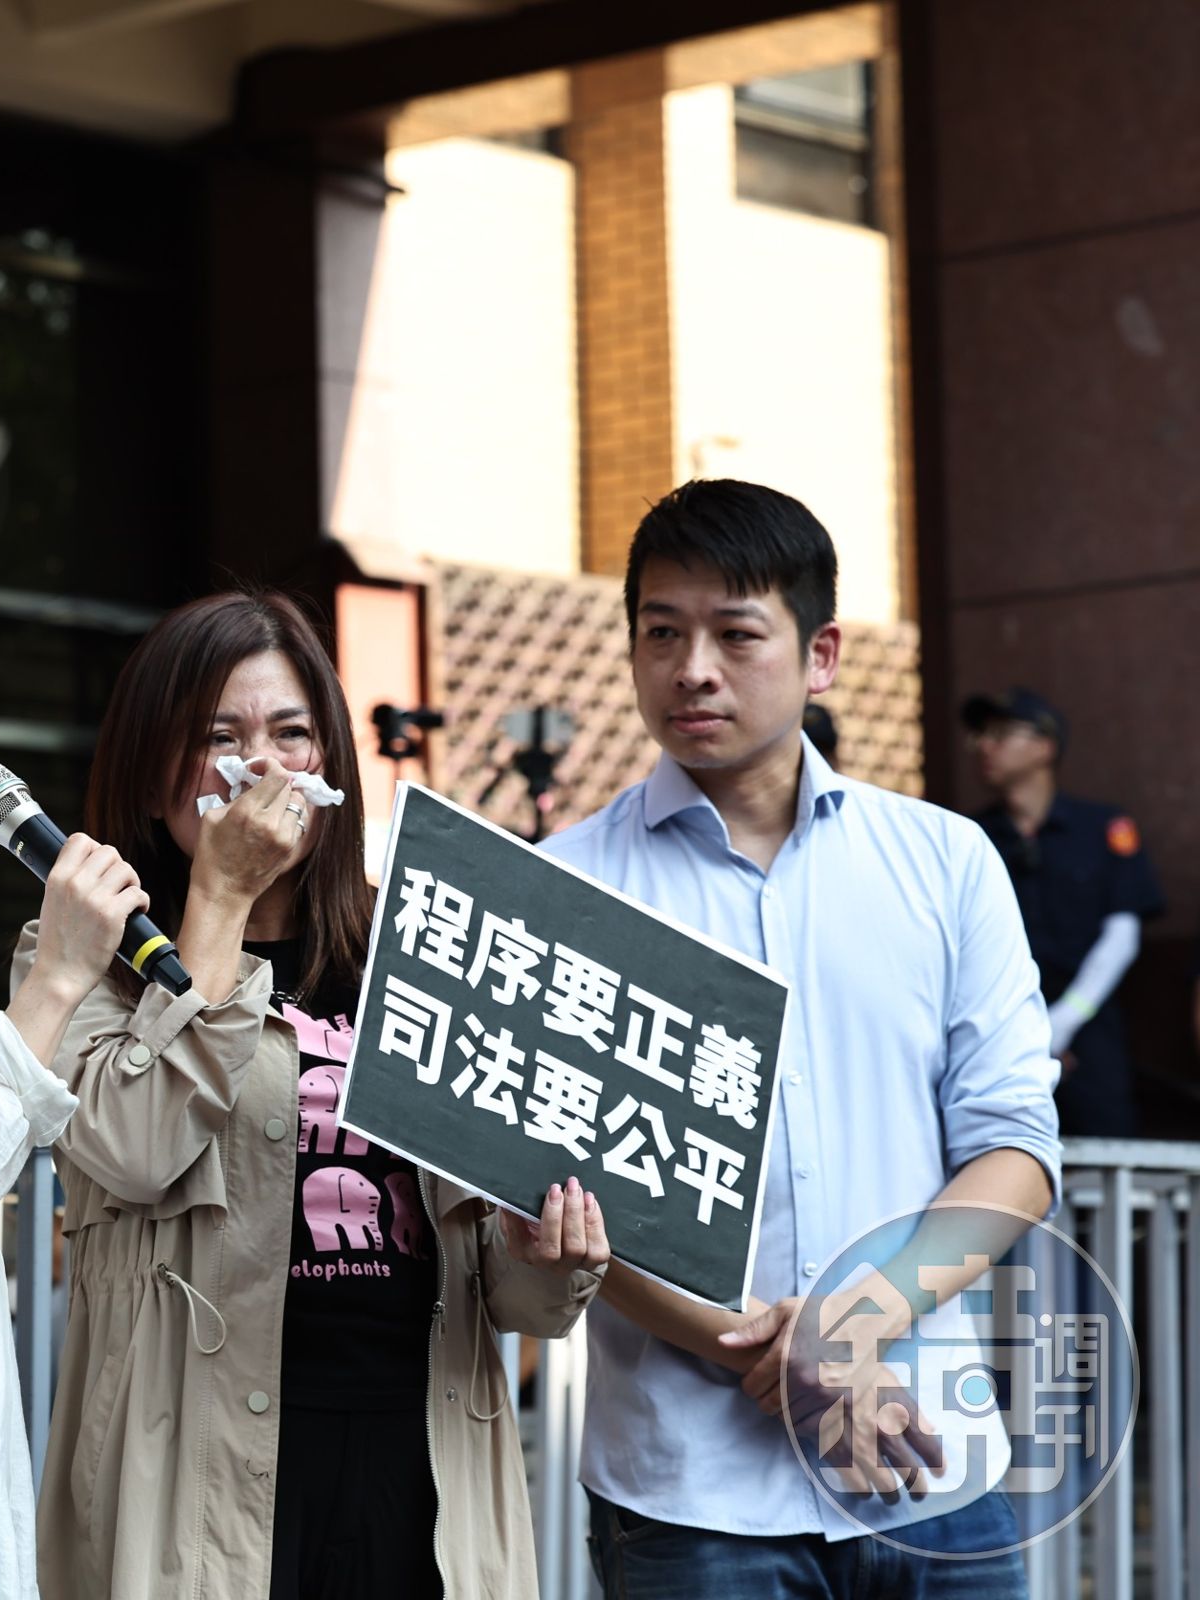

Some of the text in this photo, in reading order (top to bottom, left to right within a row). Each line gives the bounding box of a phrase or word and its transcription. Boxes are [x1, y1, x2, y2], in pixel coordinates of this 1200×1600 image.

[378, 974, 745, 1226] 司法要公平
[394, 866, 762, 1130] 程序要正義
